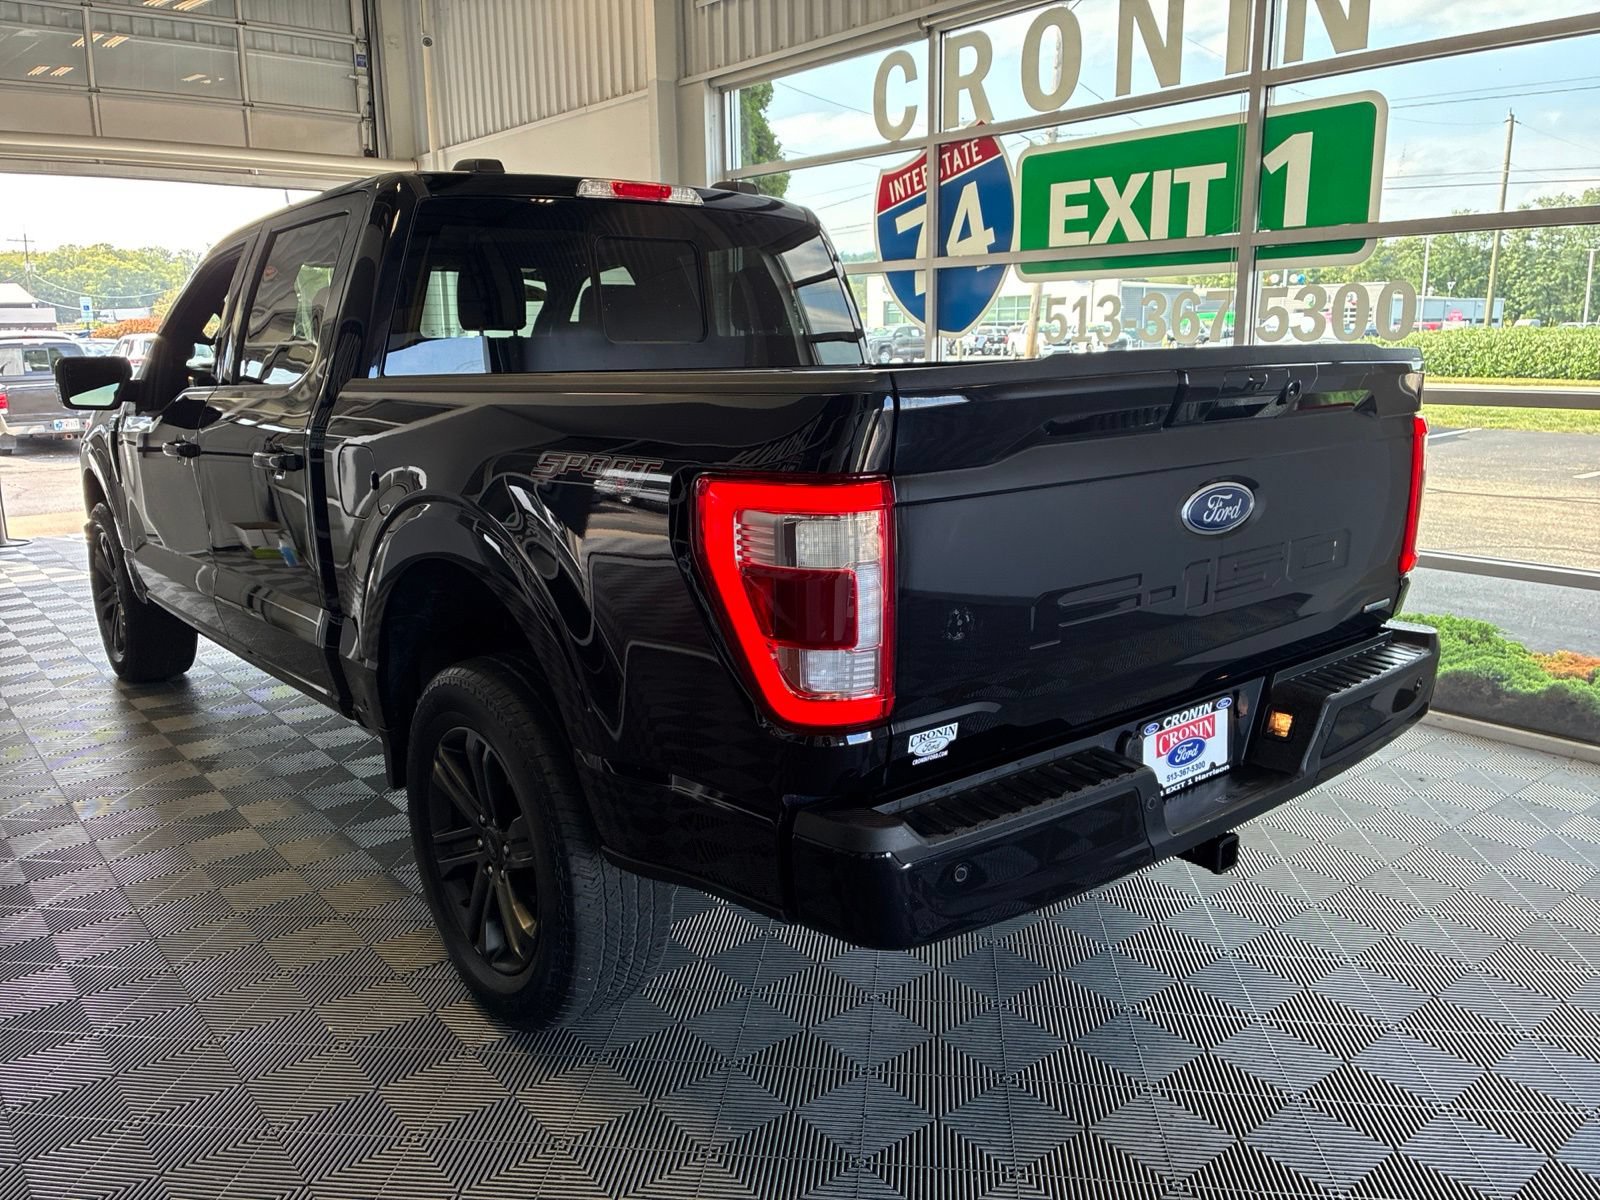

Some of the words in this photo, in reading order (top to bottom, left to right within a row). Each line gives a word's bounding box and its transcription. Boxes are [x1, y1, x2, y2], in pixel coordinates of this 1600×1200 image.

[888, 138, 983, 204] INTERTATE
[1049, 163, 1227, 247] EXIT
[1262, 131, 1314, 229] 1
[895, 181, 996, 296] 74
[1045, 280, 1417, 346] 513-3675300
[531, 451, 664, 479] SPORT
[1203, 493, 1241, 523] Ford
[1030, 528, 1352, 650] F-150
[1163, 702, 1213, 729] CRONIN
[911, 724, 956, 748] CRONIN
[1158, 718, 1213, 754] CRONIN
[1175, 742, 1199, 763] Ford
[1166, 761, 1206, 782] 513-367-5300
[1166, 781, 1186, 795] EXIT
[1187, 778, 1194, 786] 1
[1195, 764, 1230, 782] Harrison
